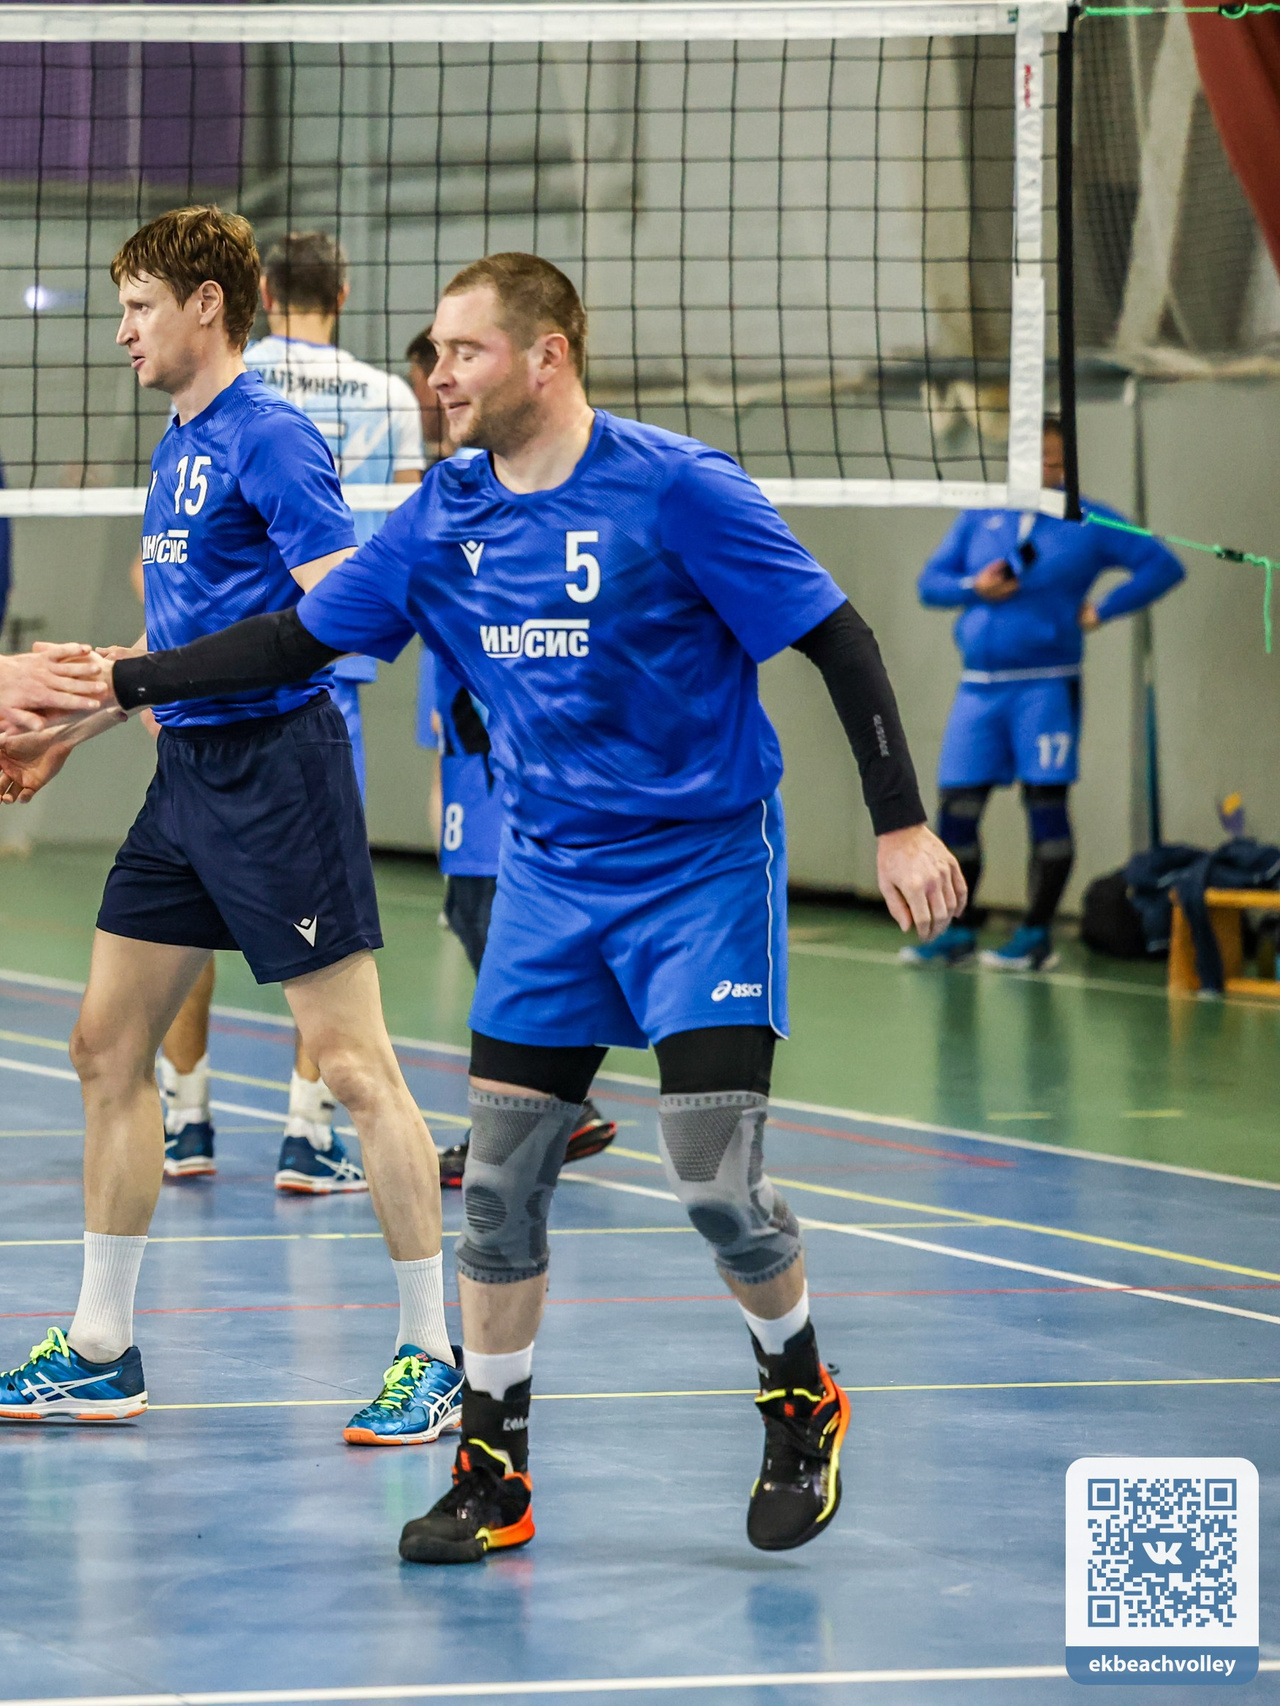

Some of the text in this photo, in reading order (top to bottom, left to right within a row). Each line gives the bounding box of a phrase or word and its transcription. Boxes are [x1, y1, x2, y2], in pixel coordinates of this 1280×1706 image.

[174, 455, 212, 516] 15
[565, 530, 601, 604] 5
[479, 618, 590, 659] ИНСИС
[444, 802, 464, 851] 8
